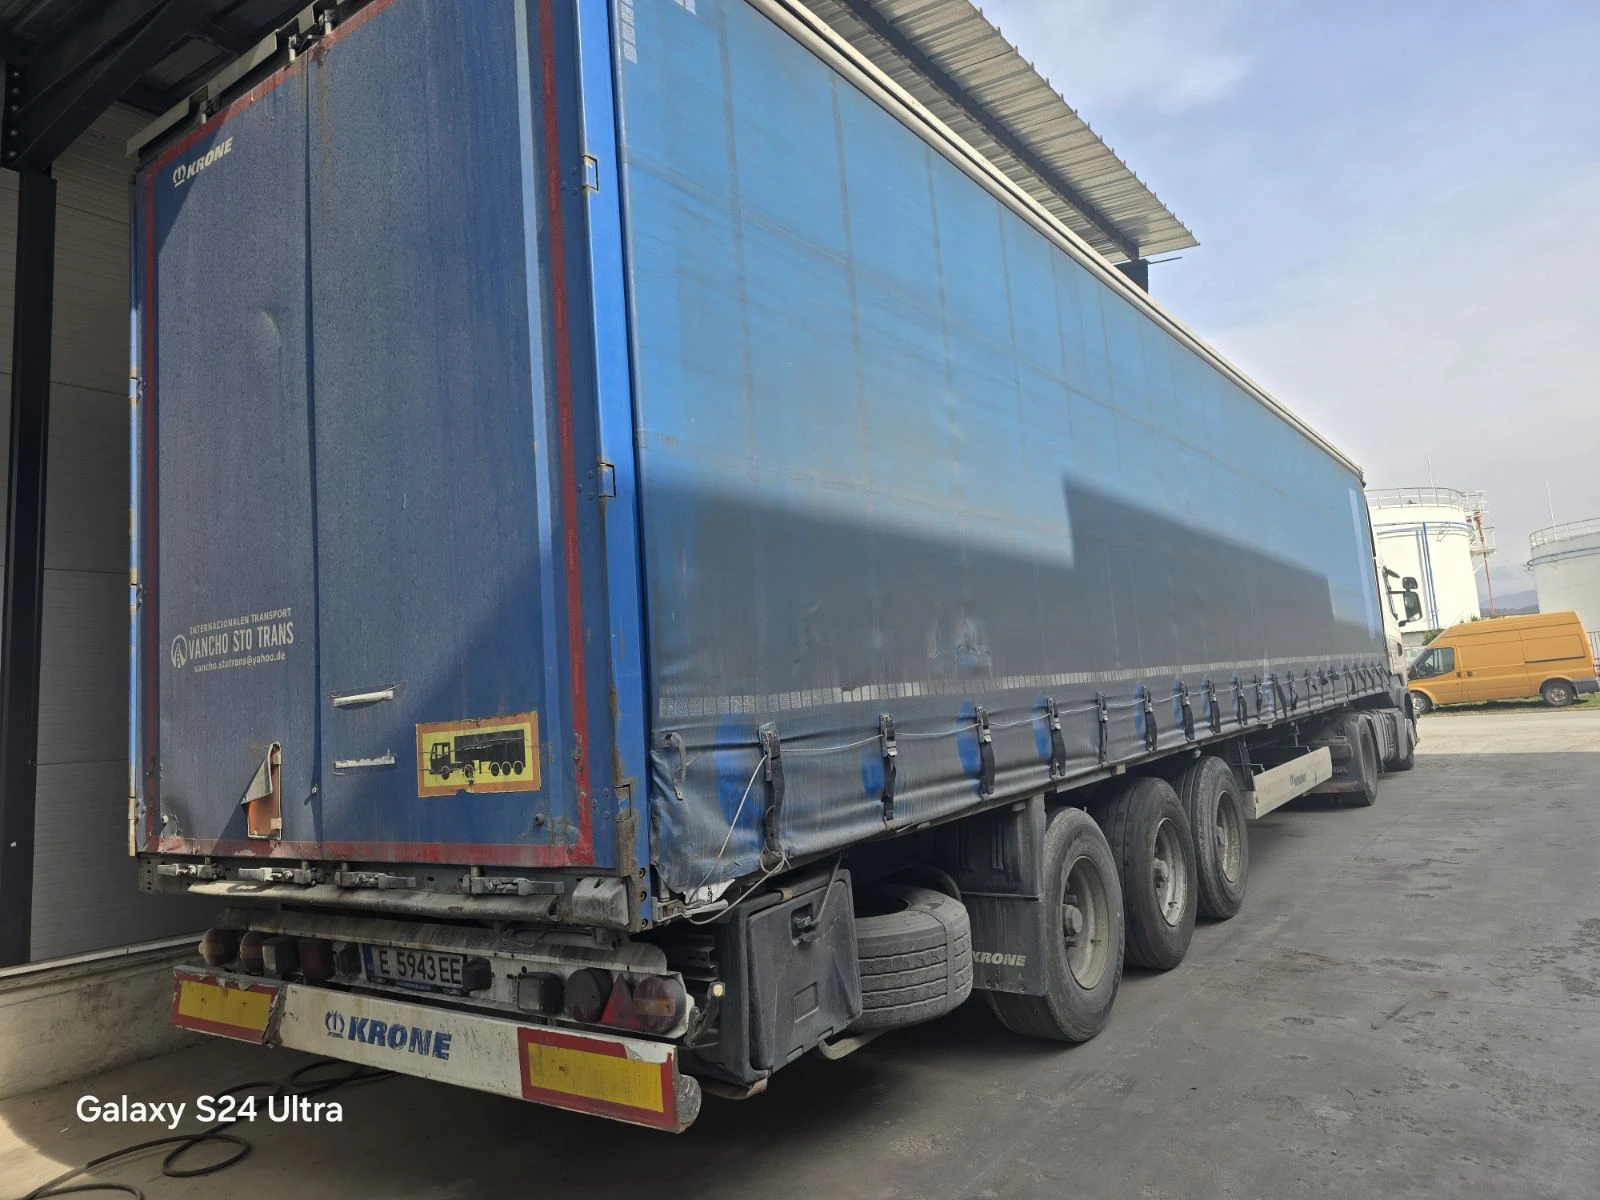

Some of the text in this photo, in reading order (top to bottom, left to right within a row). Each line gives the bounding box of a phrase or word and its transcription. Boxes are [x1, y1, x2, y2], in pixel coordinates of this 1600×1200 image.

[187, 137, 233, 179] KRONE
[190, 608, 292, 635] INTERNACIONALEN TRANSPORT
[188, 621, 294, 660] VANCHO STO TRANS
[194, 650, 286, 673] vancho.stotrans@yahoo.de
[379, 950, 390, 975] E
[348, 1016, 452, 1060] KRONE
